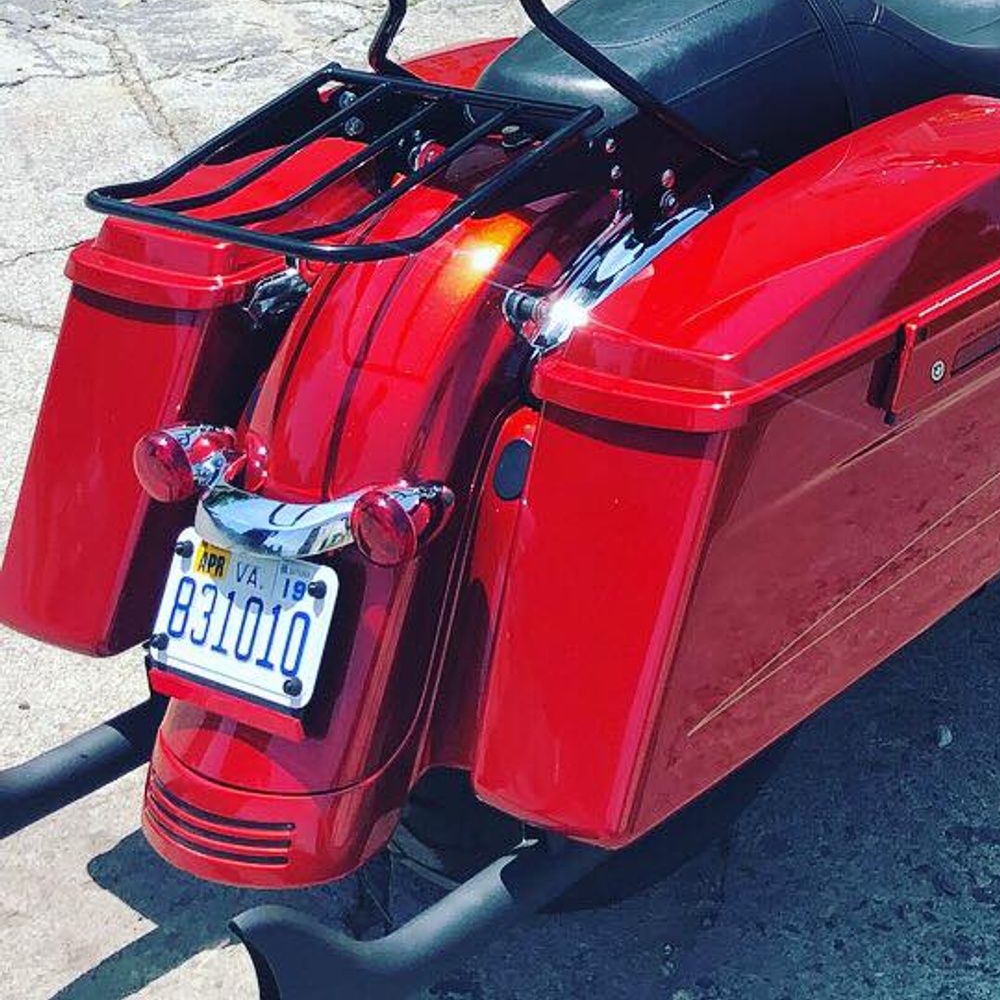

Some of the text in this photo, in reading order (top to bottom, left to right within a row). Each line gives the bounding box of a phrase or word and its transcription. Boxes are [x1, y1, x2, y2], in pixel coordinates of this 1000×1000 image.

[198, 551, 225, 577] APR
[282, 578, 306, 601] 19
[168, 577, 311, 677] 831010
